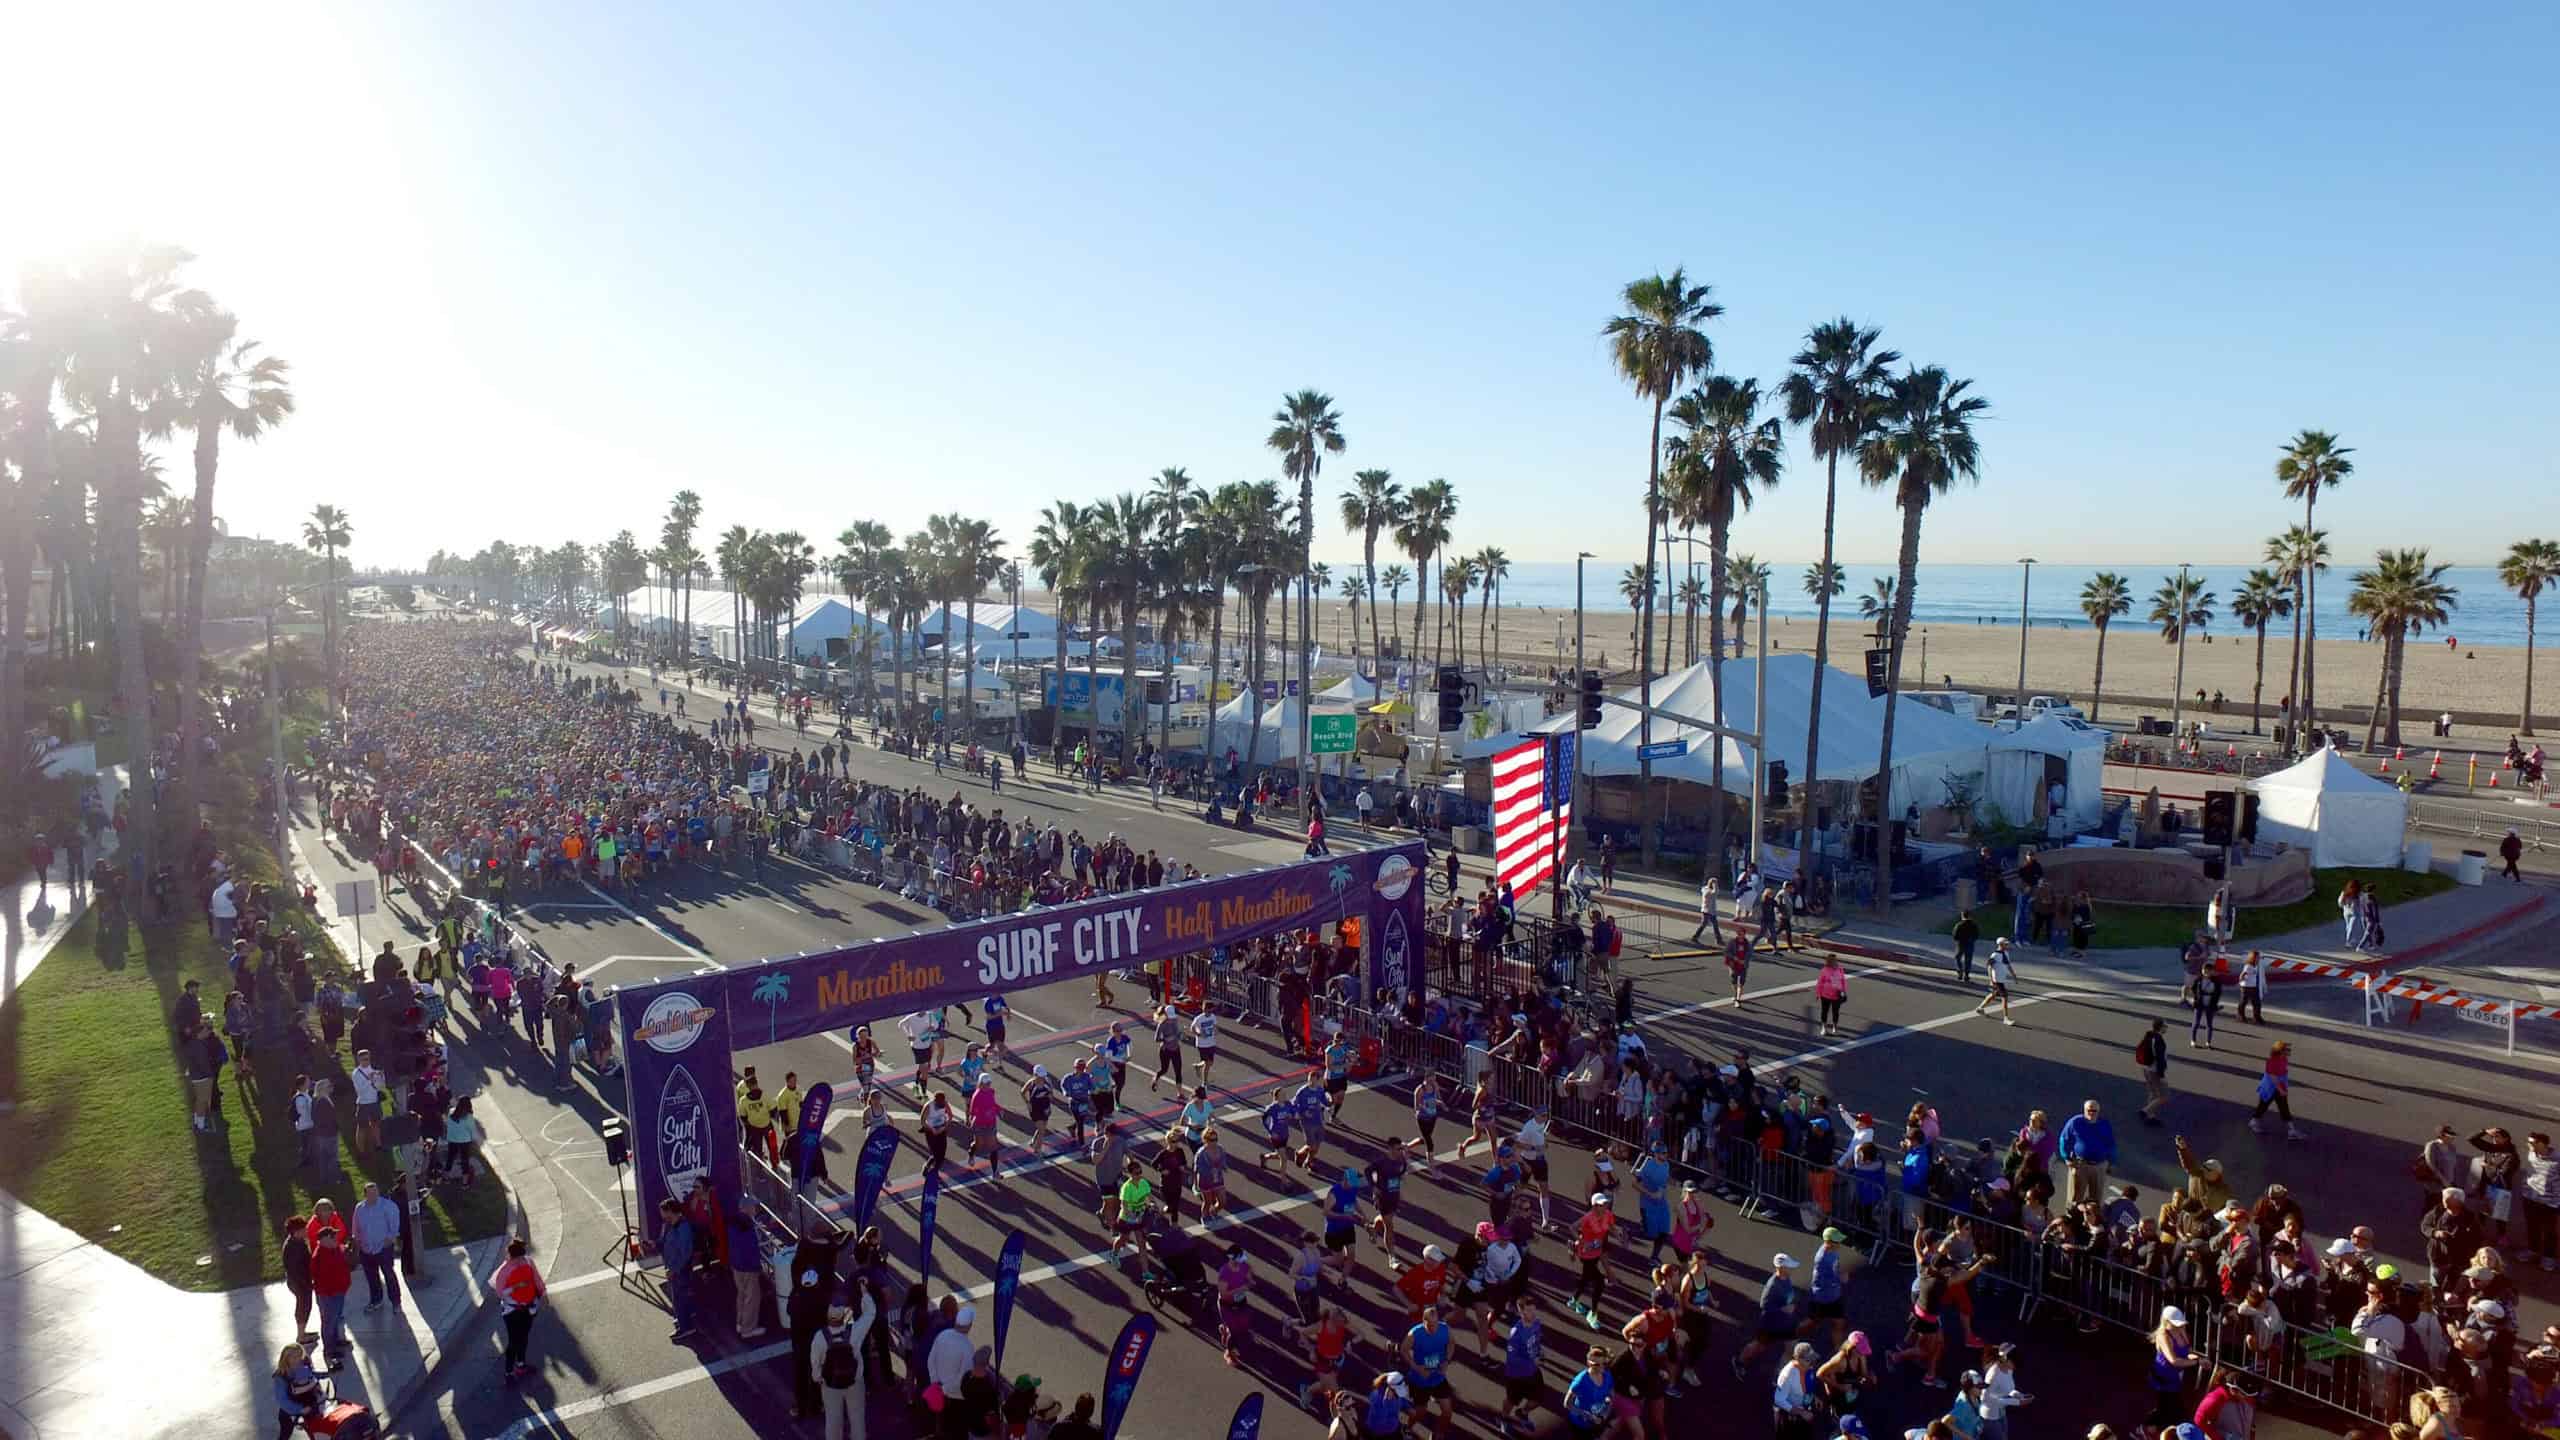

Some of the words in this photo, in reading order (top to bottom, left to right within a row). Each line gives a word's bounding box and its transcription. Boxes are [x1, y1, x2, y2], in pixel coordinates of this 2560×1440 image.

[1165, 900, 1216, 942] Half
[1221, 891, 1314, 929] Marathon
[977, 921, 1062, 985] SURF
[1073, 906, 1143, 965] CITY
[1385, 939, 1406, 968] Surf
[817, 959, 945, 1014] Marathon
[2457, 1007, 2509, 1025] CLOSED
[663, 1105, 701, 1144] Surf
[671, 1138, 701, 1170] City
